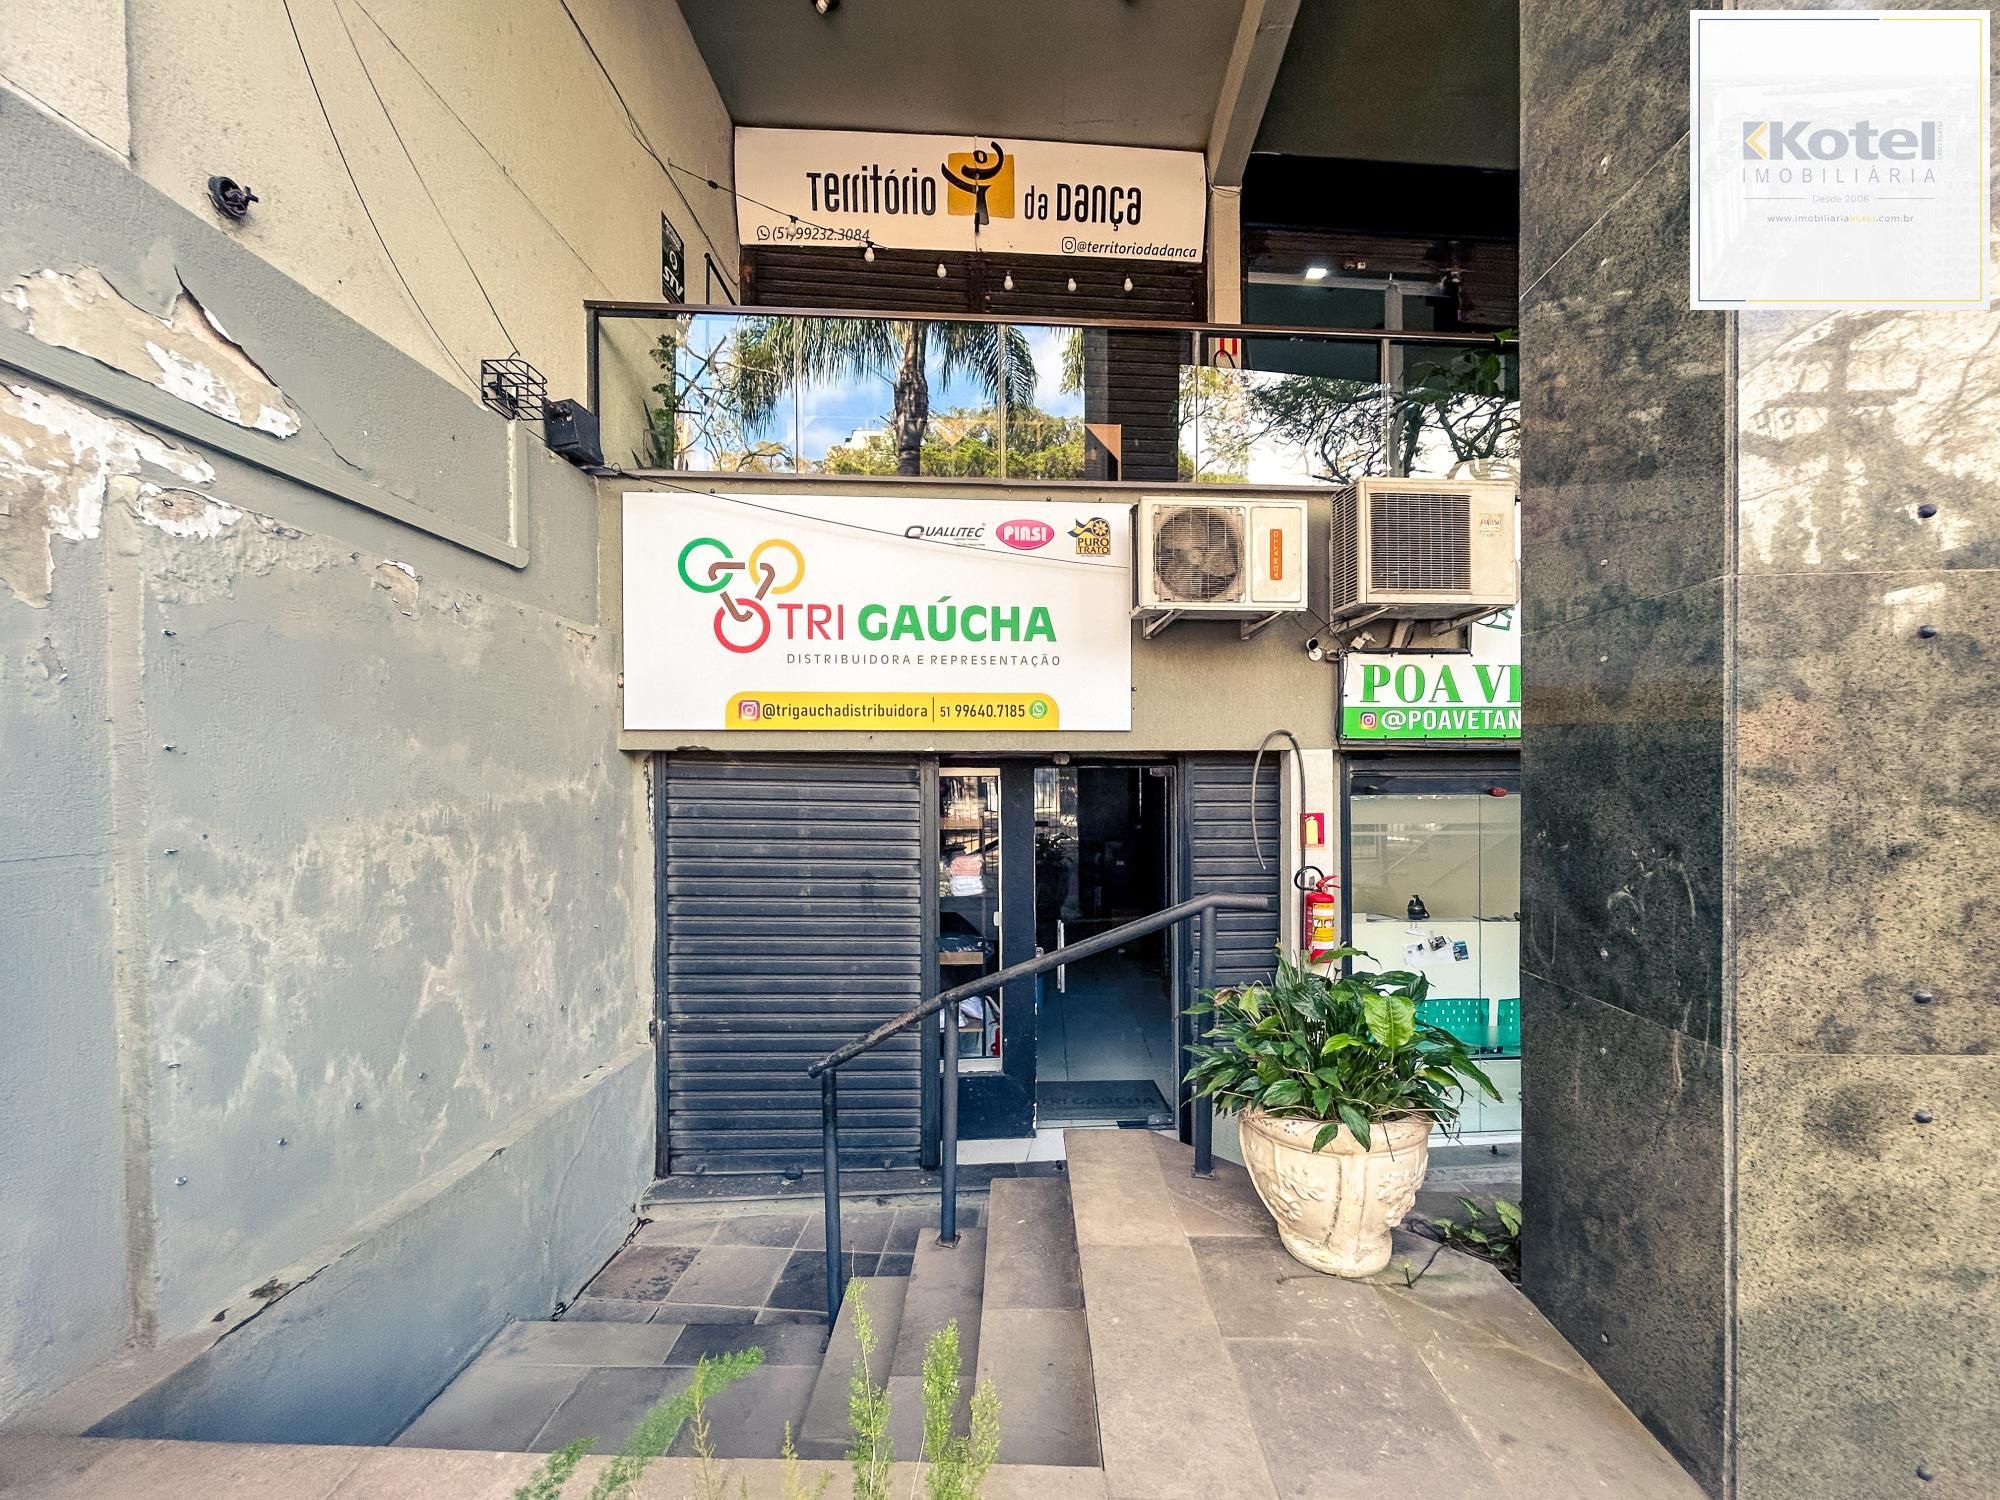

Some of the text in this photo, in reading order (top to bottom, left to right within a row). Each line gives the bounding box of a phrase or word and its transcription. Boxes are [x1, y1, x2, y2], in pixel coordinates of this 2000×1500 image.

[806, 164, 936, 216] Território
[1024, 183, 1142, 232] da Dança
[1077, 240, 1197, 258] @territoriodadanca
[662, 265, 684, 296] STV
[1077, 537, 1110, 547] PURO
[1078, 546, 1110, 554] TRATO
[777, 595, 1057, 642] TRI GAÚCHA
[786, 653, 1061, 668] DISTRIBUIDORA E REPRESENTAÇÃO
[1360, 664, 1464, 703] POA
[762, 703, 1025, 720] @trigauchadistribuidora 51 99640.7185
